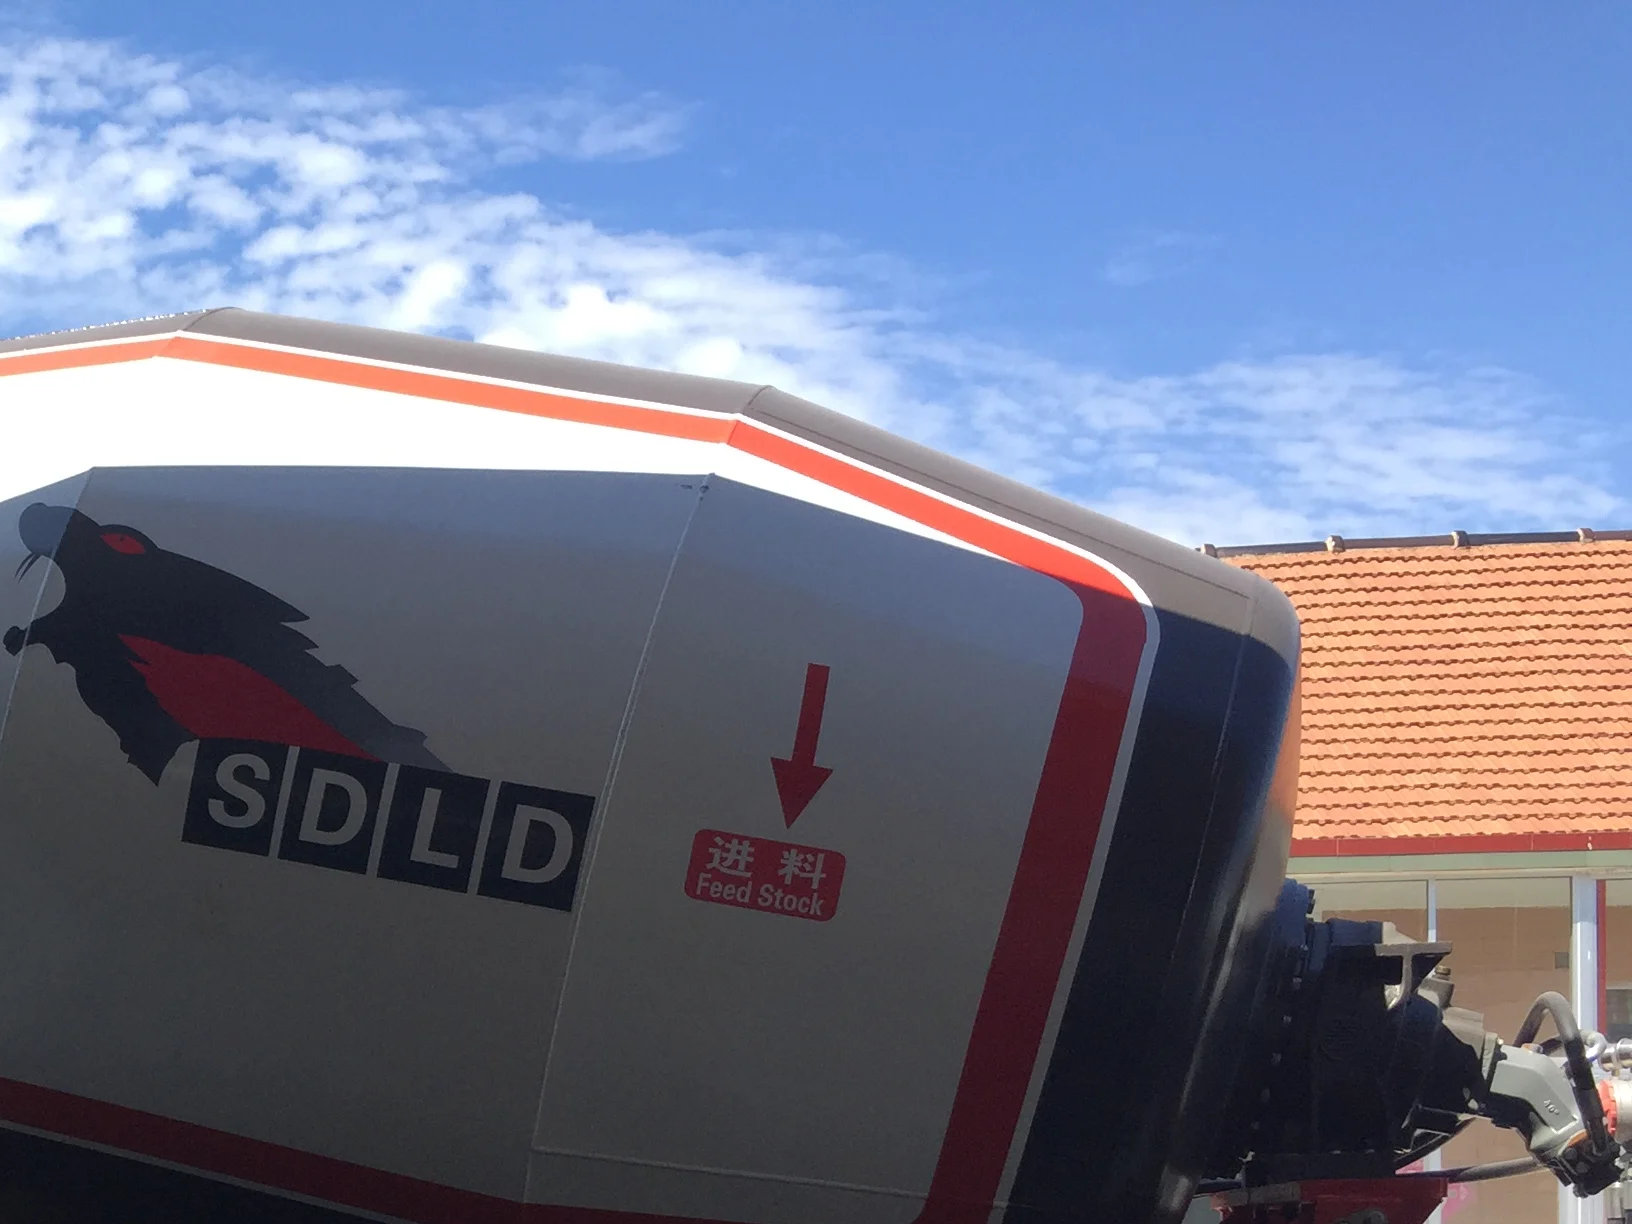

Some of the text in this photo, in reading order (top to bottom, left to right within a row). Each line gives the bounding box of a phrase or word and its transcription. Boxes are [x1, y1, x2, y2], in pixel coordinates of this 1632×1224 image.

[207, 752, 574, 885] SDLD
[706, 835, 827, 890] 进料
[695, 872, 824, 917] Feed Stock
